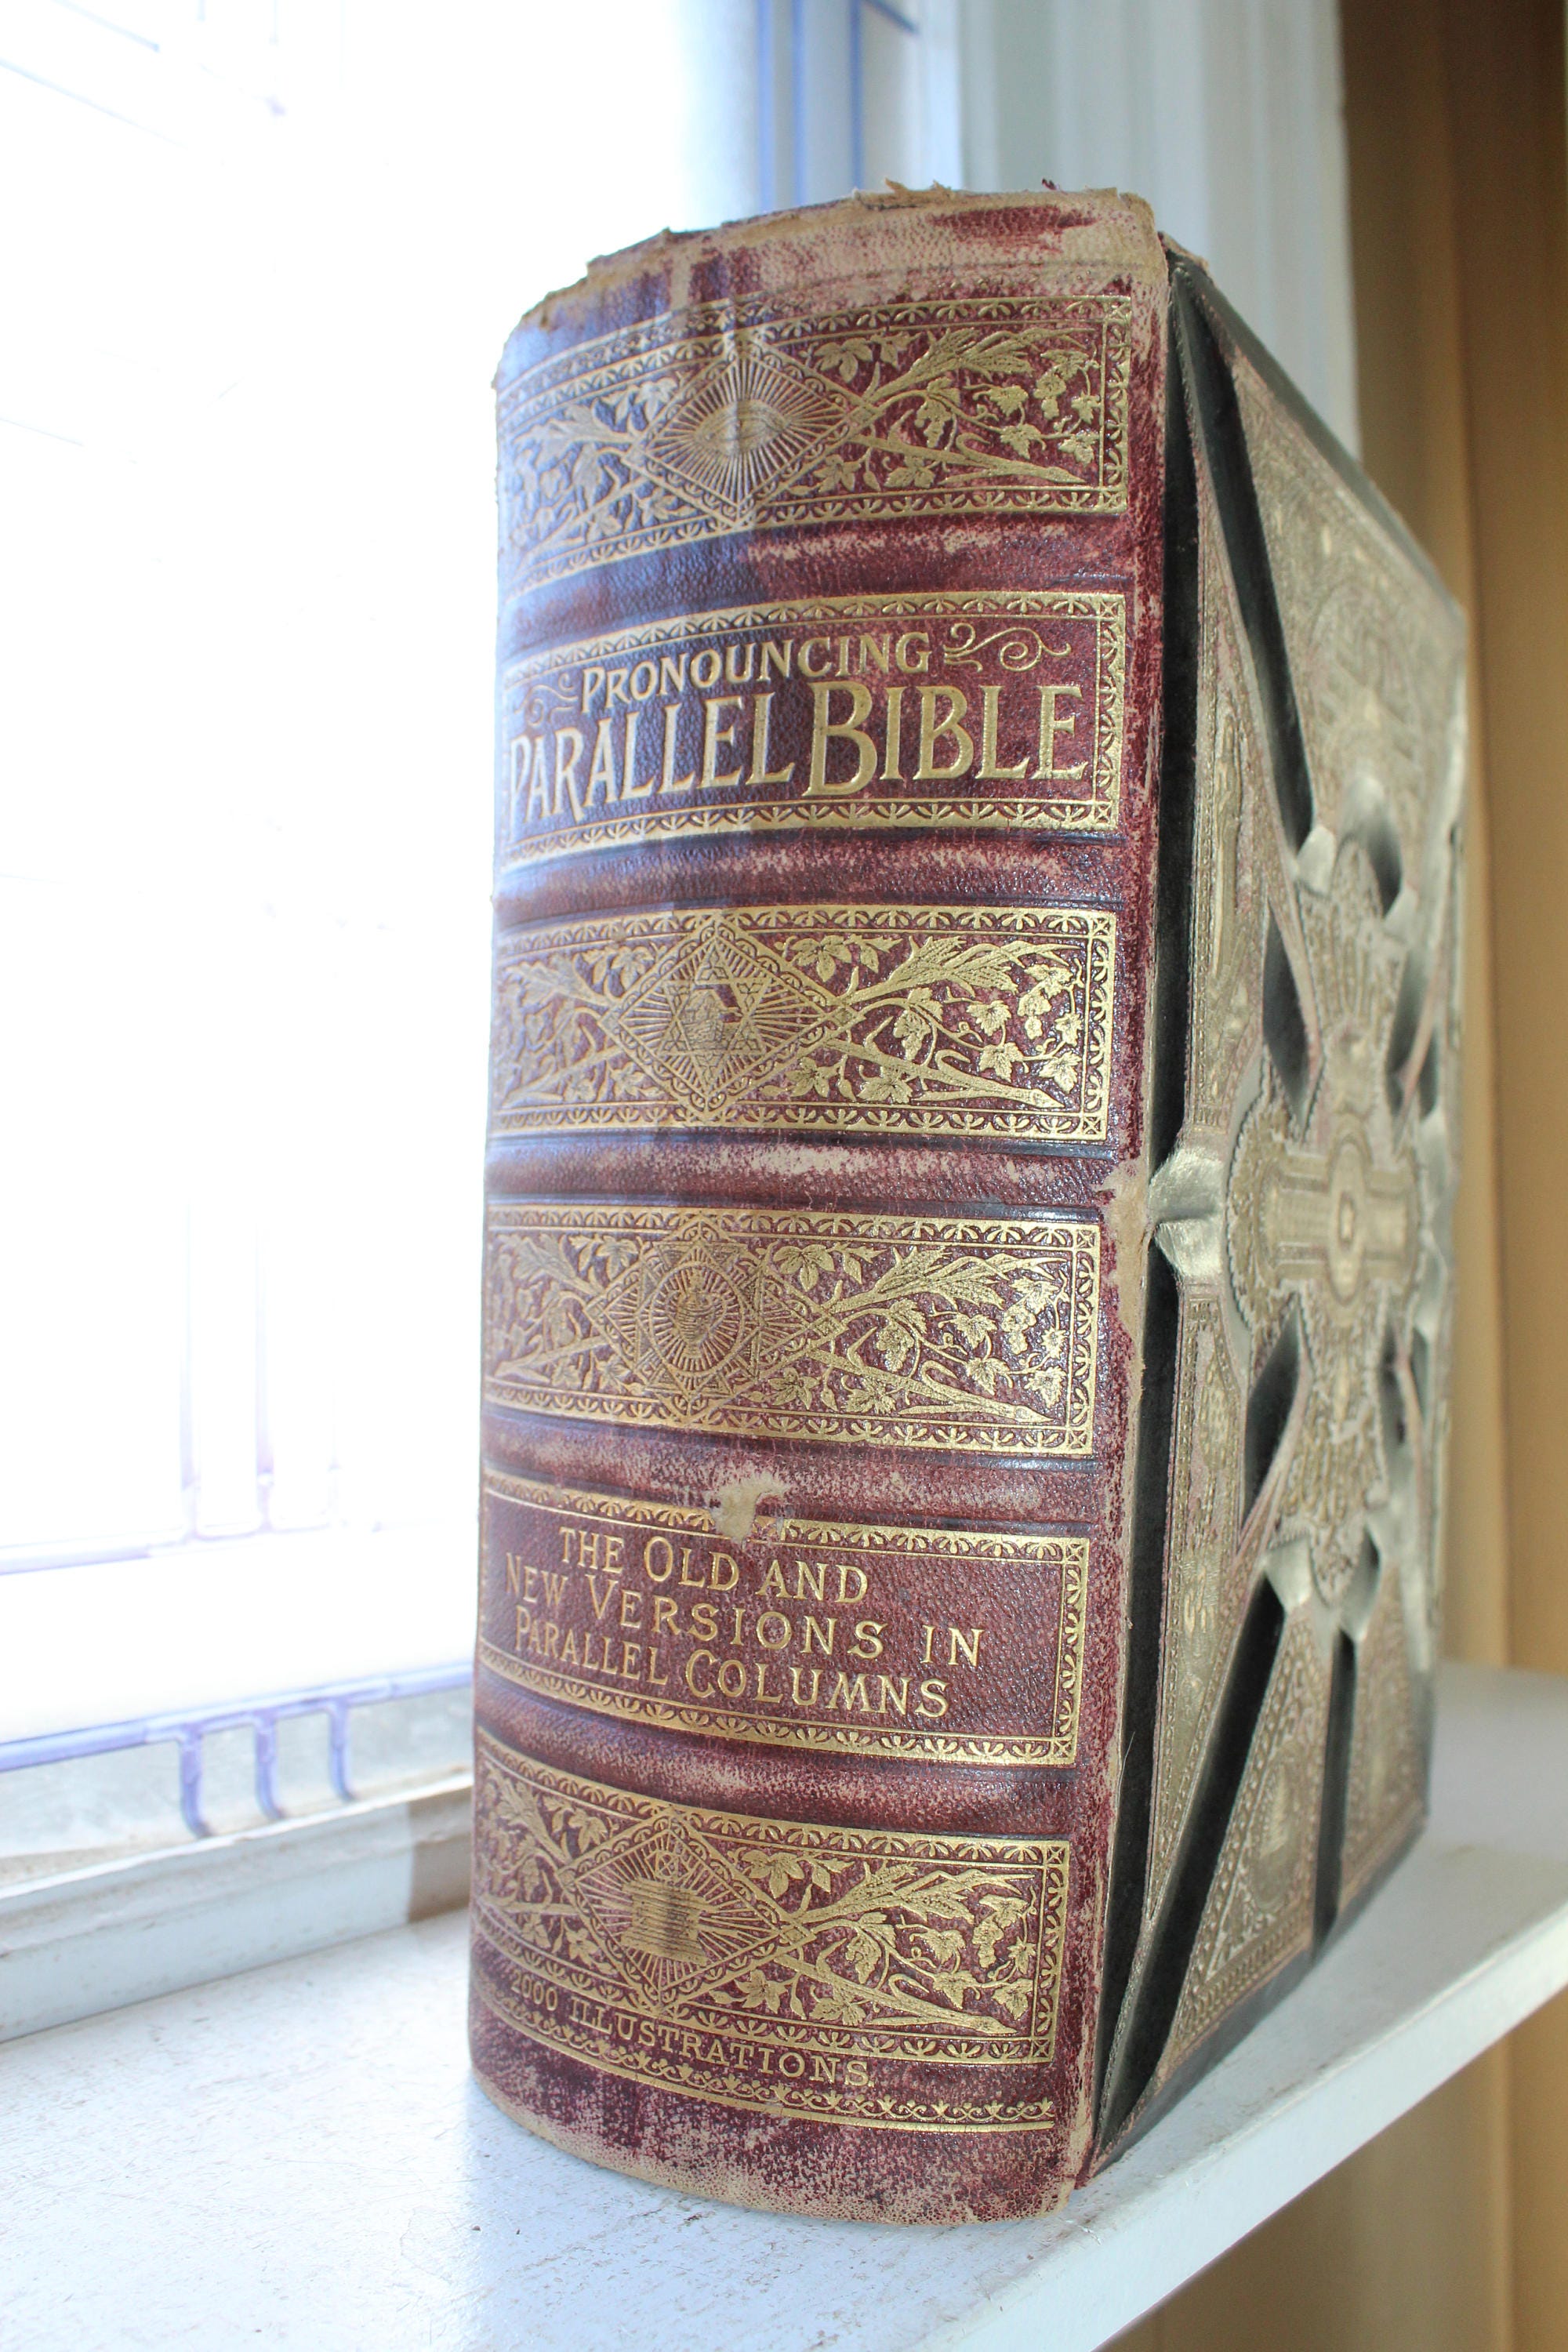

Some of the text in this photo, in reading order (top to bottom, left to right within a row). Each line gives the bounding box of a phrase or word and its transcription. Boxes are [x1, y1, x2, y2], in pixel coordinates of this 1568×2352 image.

[581, 631, 932, 713] PRONOUNCING
[509, 681, 1089, 834] PARALLEL BIBLE
[505, 1553, 985, 1667] NEW VERSIONS IN
[558, 1526, 868, 1604] THE OLD AND
[514, 1608, 950, 1719] PARALLEL COLUMNS
[510, 1969, 876, 2089] 2000 ILLUSTRATIONS.
